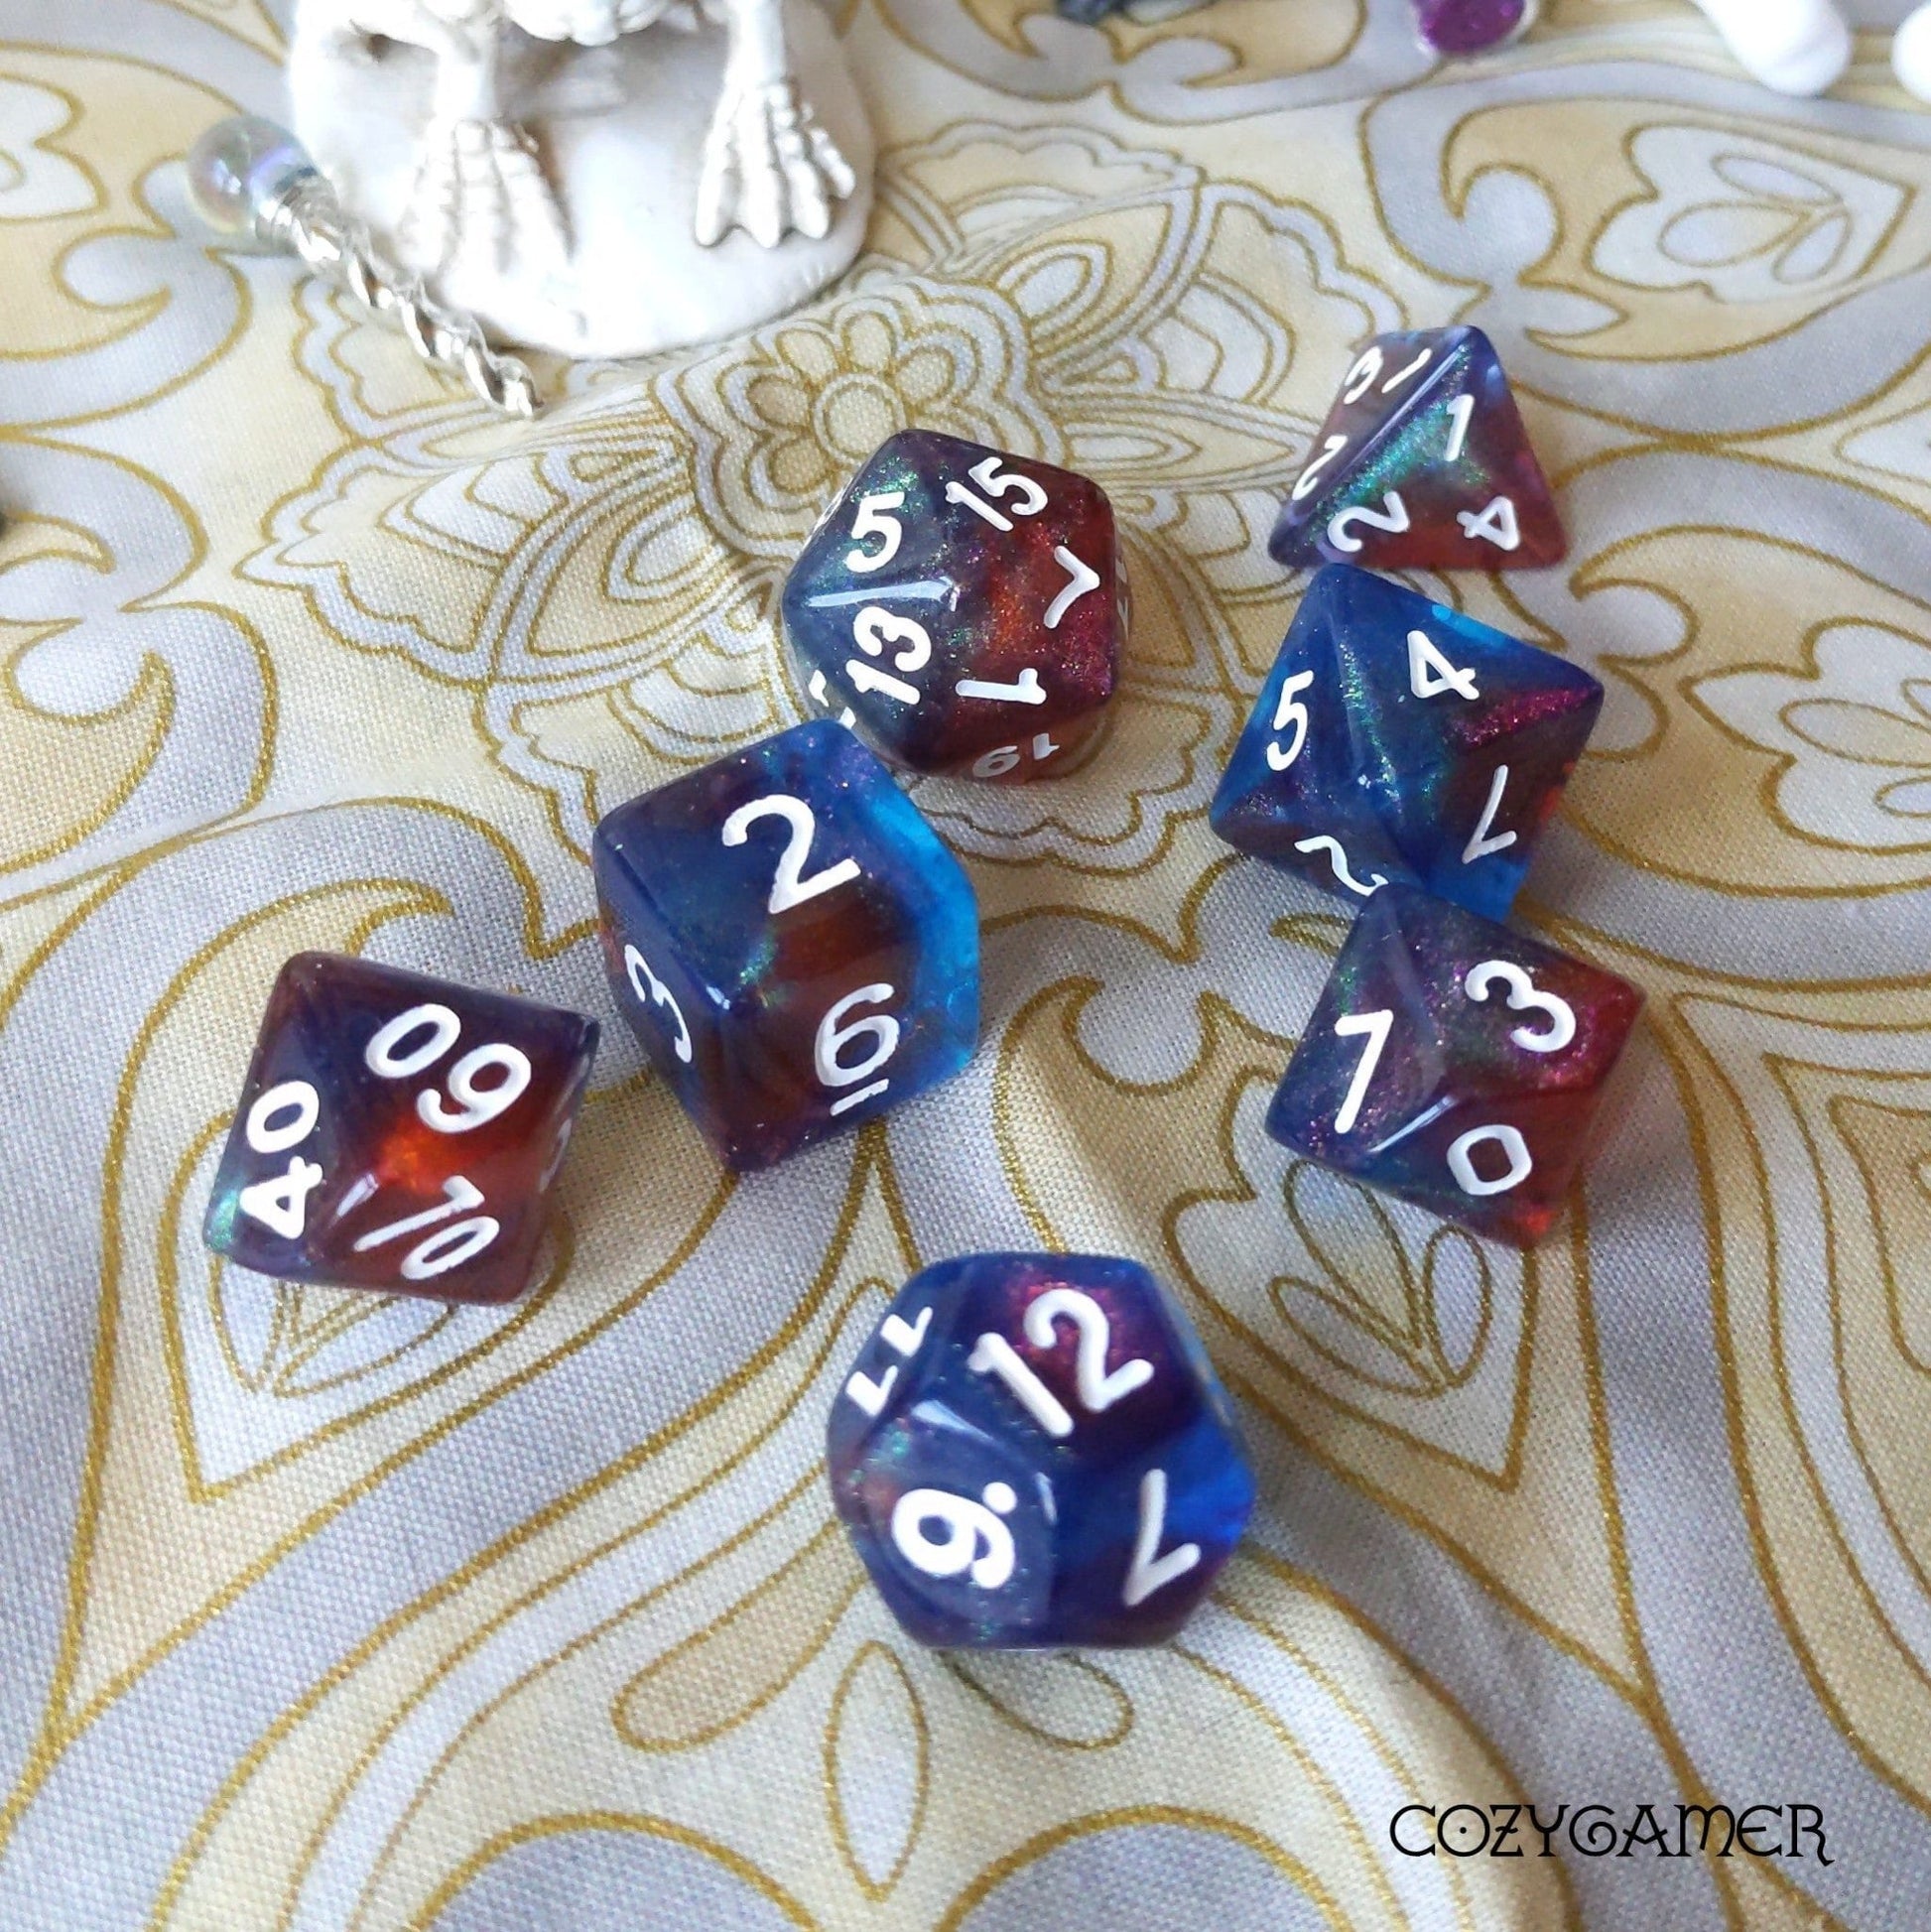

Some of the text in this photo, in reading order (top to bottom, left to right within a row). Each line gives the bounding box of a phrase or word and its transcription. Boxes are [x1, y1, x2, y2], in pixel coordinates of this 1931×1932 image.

[1381, 347, 1432, 394] 1
[1445, 394, 1475, 461] 1
[844, 491, 905, 574] 5
[945, 456, 1048, 532] 15
[1327, 491, 1410, 553] 2
[1456, 496, 1520, 551] 4
[1043, 545, 1100, 629] 7
[845, 605, 932, 706] 13
[955, 667, 1047, 706] 1
[1407, 629, 1480, 701] 4
[1265, 670, 1314, 771] 5
[721, 794, 861, 914] 2
[1461, 764, 1518, 864] 7
[624, 944, 693, 1064] 3
[1464, 960, 1577, 1053] 3
[1334, 1008, 1394, 1134] 7
[239, 1080, 323, 1240] 40
[1446, 1123, 1533, 1197] 0
[353, 1175, 501, 1281] 10
[967, 1288, 1155, 1438] 12
[1122, 1468, 1202, 1607] 7
